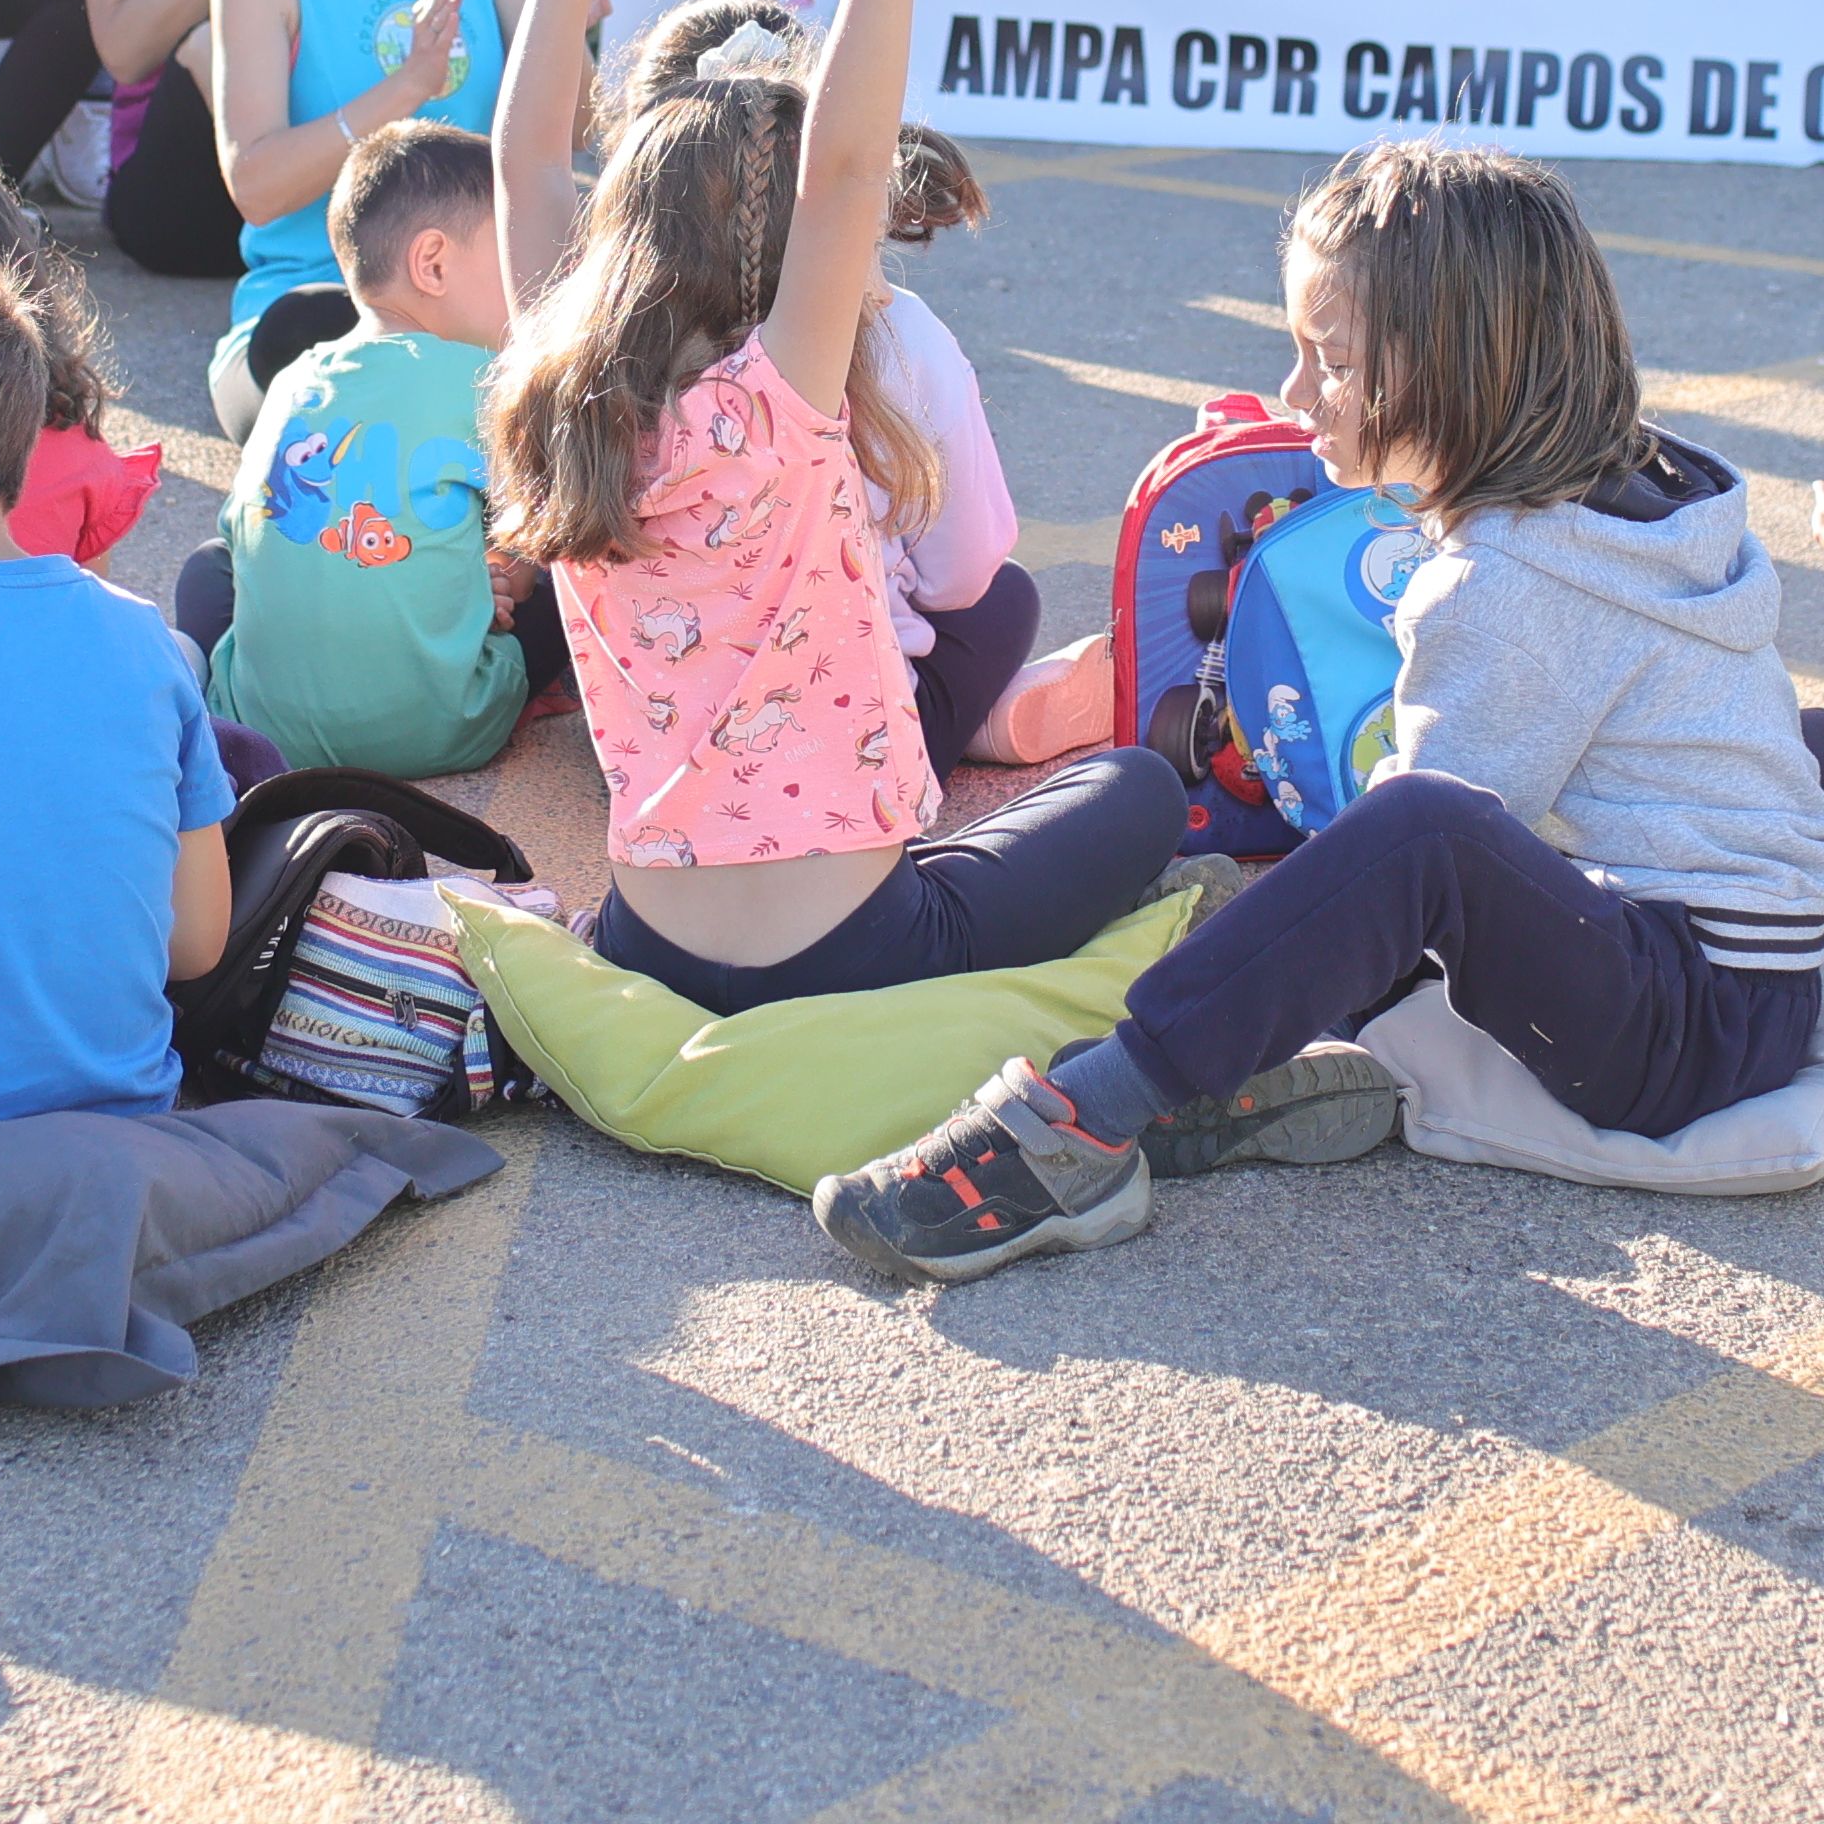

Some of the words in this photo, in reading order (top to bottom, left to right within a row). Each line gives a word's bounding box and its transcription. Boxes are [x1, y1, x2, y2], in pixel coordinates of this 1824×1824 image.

[938, 15, 1149, 106] AMPA
[1171, 29, 1319, 118] CPR
[1342, 42, 1665, 136] CAMPOS
[1687, 58, 1781, 140] DE
